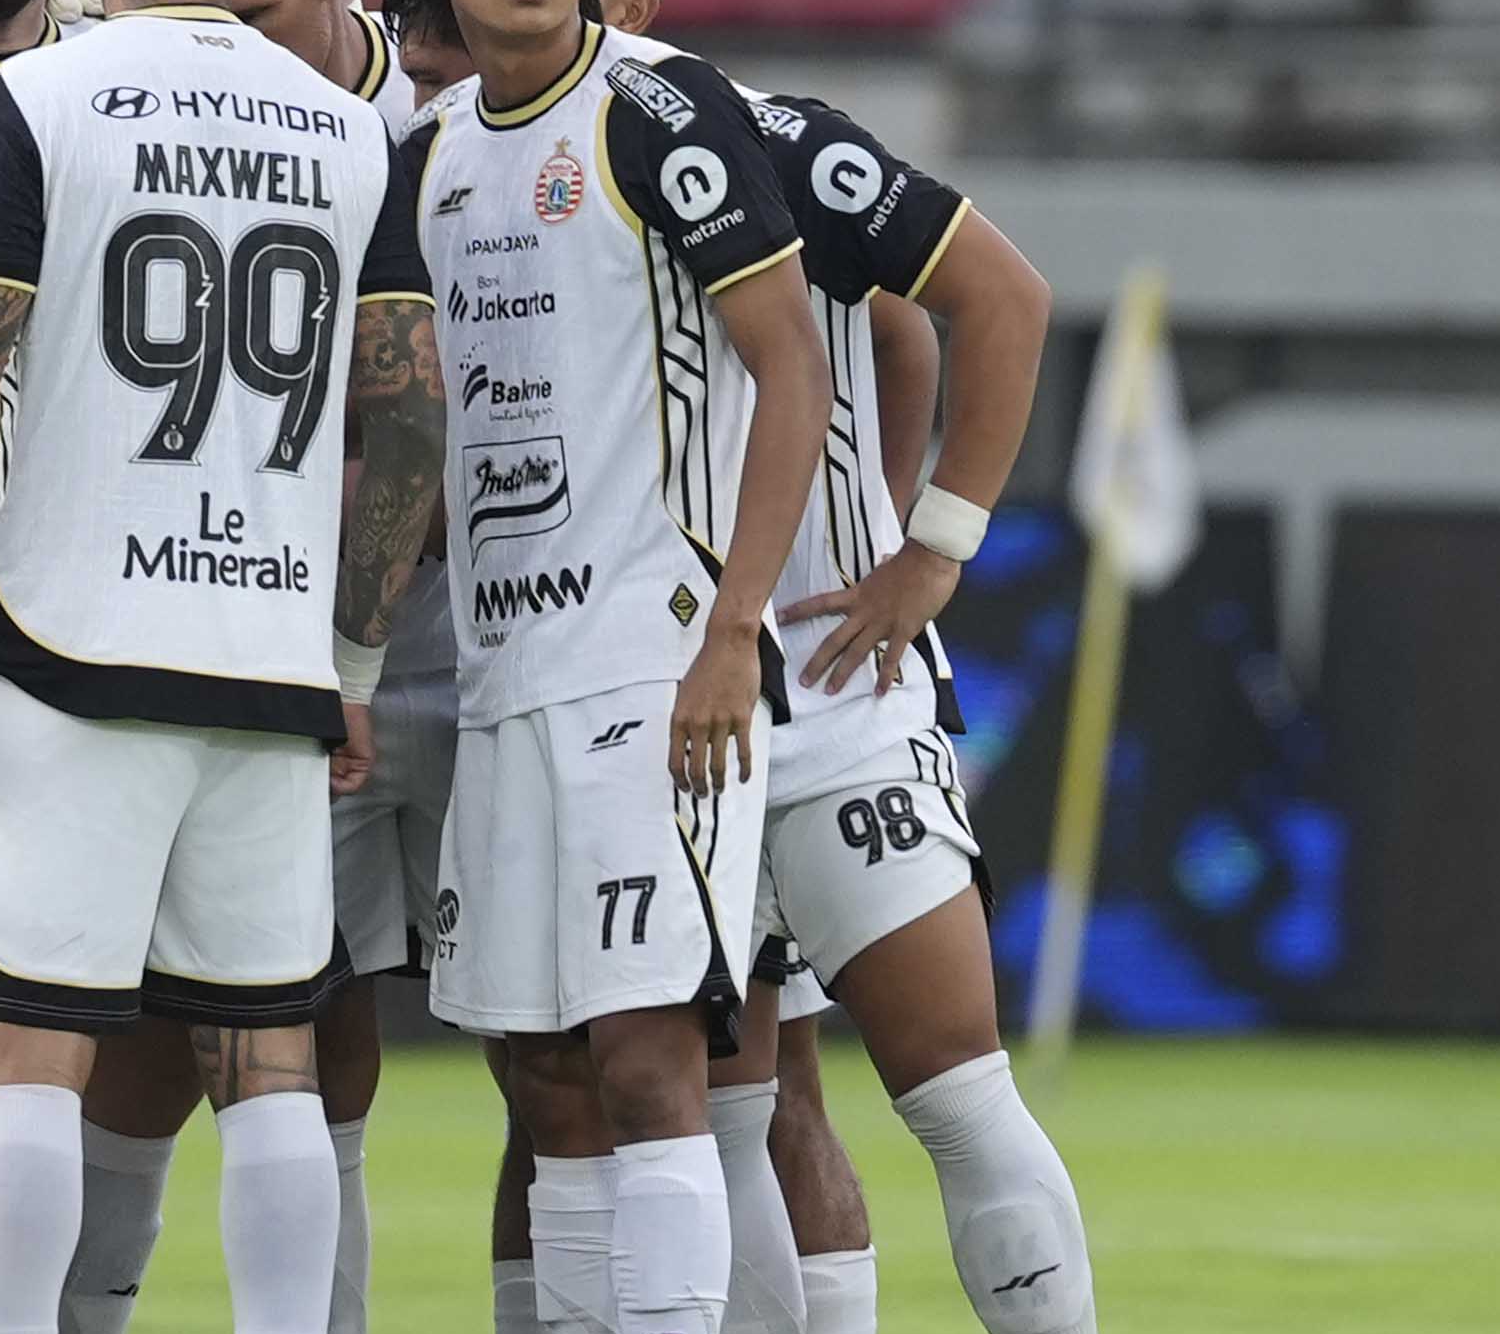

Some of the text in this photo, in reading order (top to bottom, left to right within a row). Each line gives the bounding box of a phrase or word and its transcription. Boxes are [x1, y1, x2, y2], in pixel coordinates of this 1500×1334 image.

[171, 90, 347, 141] HYUNDAI
[133, 143, 332, 209] MAXWELL
[681, 208, 745, 249] netzme
[471, 289, 556, 323] Jakarta
[97, 208, 341, 479] 99
[199, 491, 245, 544] Le
[122, 533, 310, 593] Minerale
[837, 786, 927, 867] 98
[597, 875, 656, 950] 77
